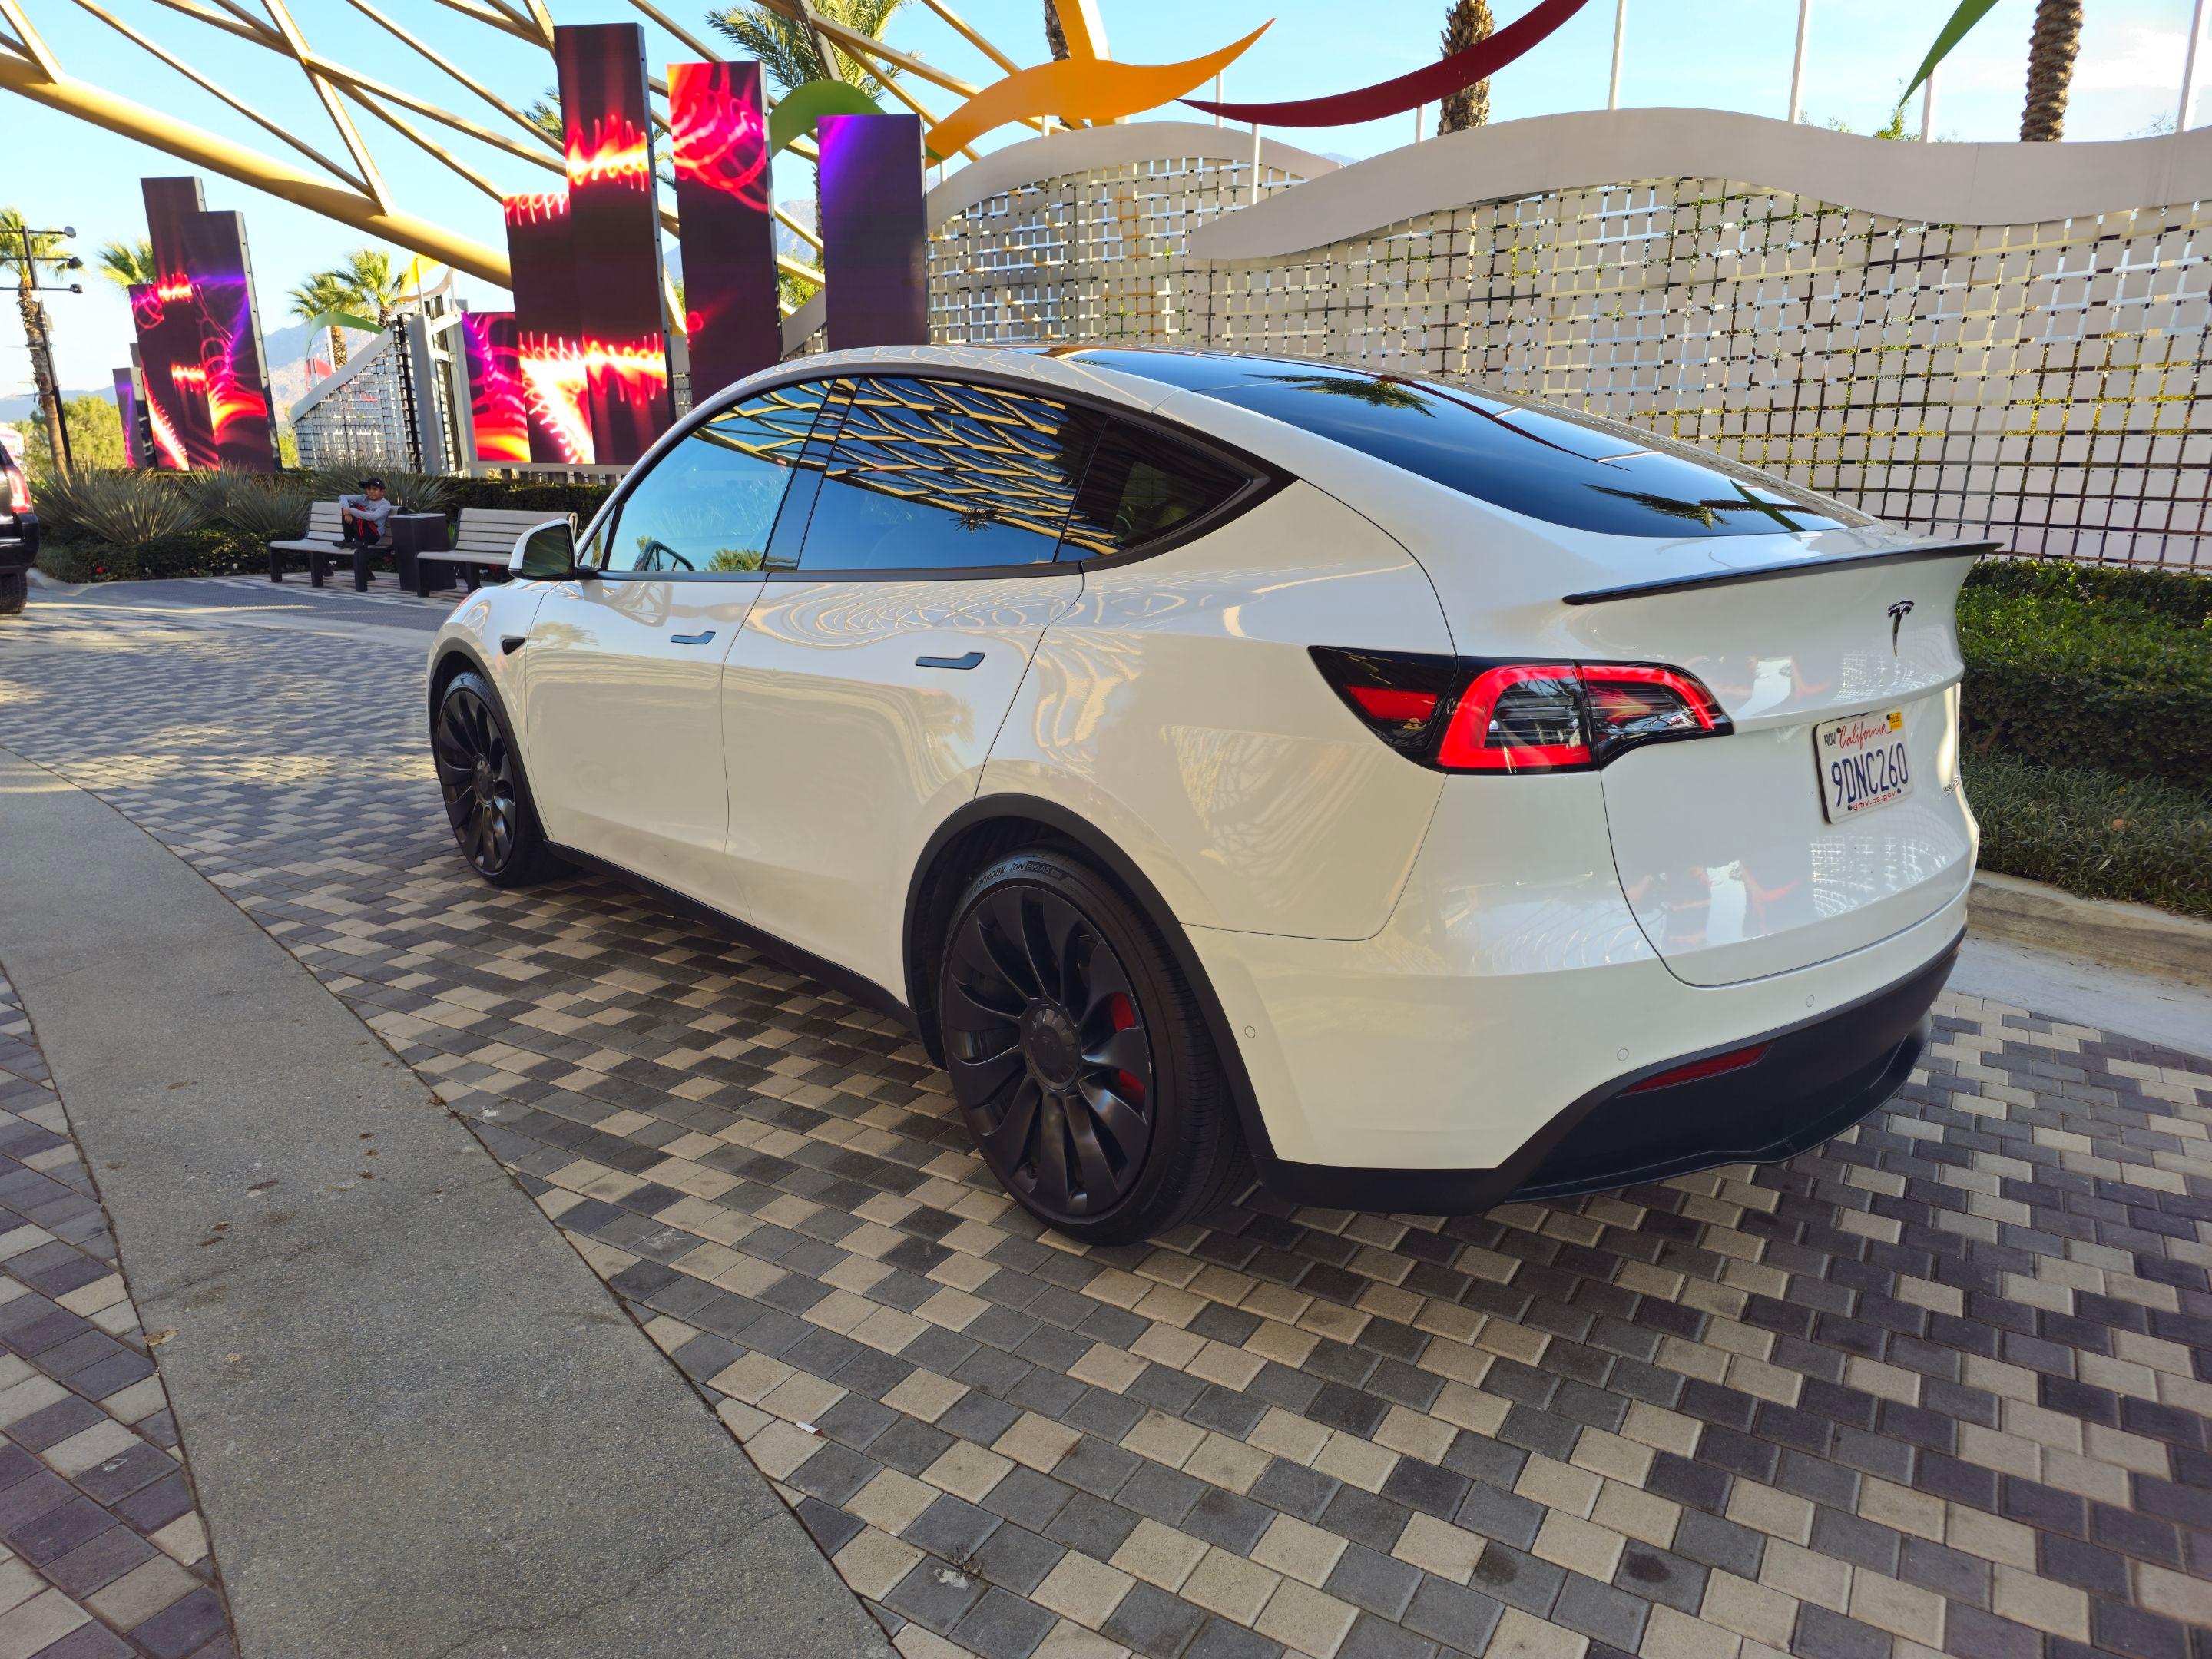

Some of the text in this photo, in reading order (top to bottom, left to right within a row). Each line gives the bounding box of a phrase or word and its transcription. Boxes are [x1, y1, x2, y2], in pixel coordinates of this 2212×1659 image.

[1824, 732, 1836, 747] NOV
[1839, 721, 1892, 750] California
[1831, 743, 1909, 807] 9DNC260
[1853, 790, 1896, 810] dmv.ca.gov
